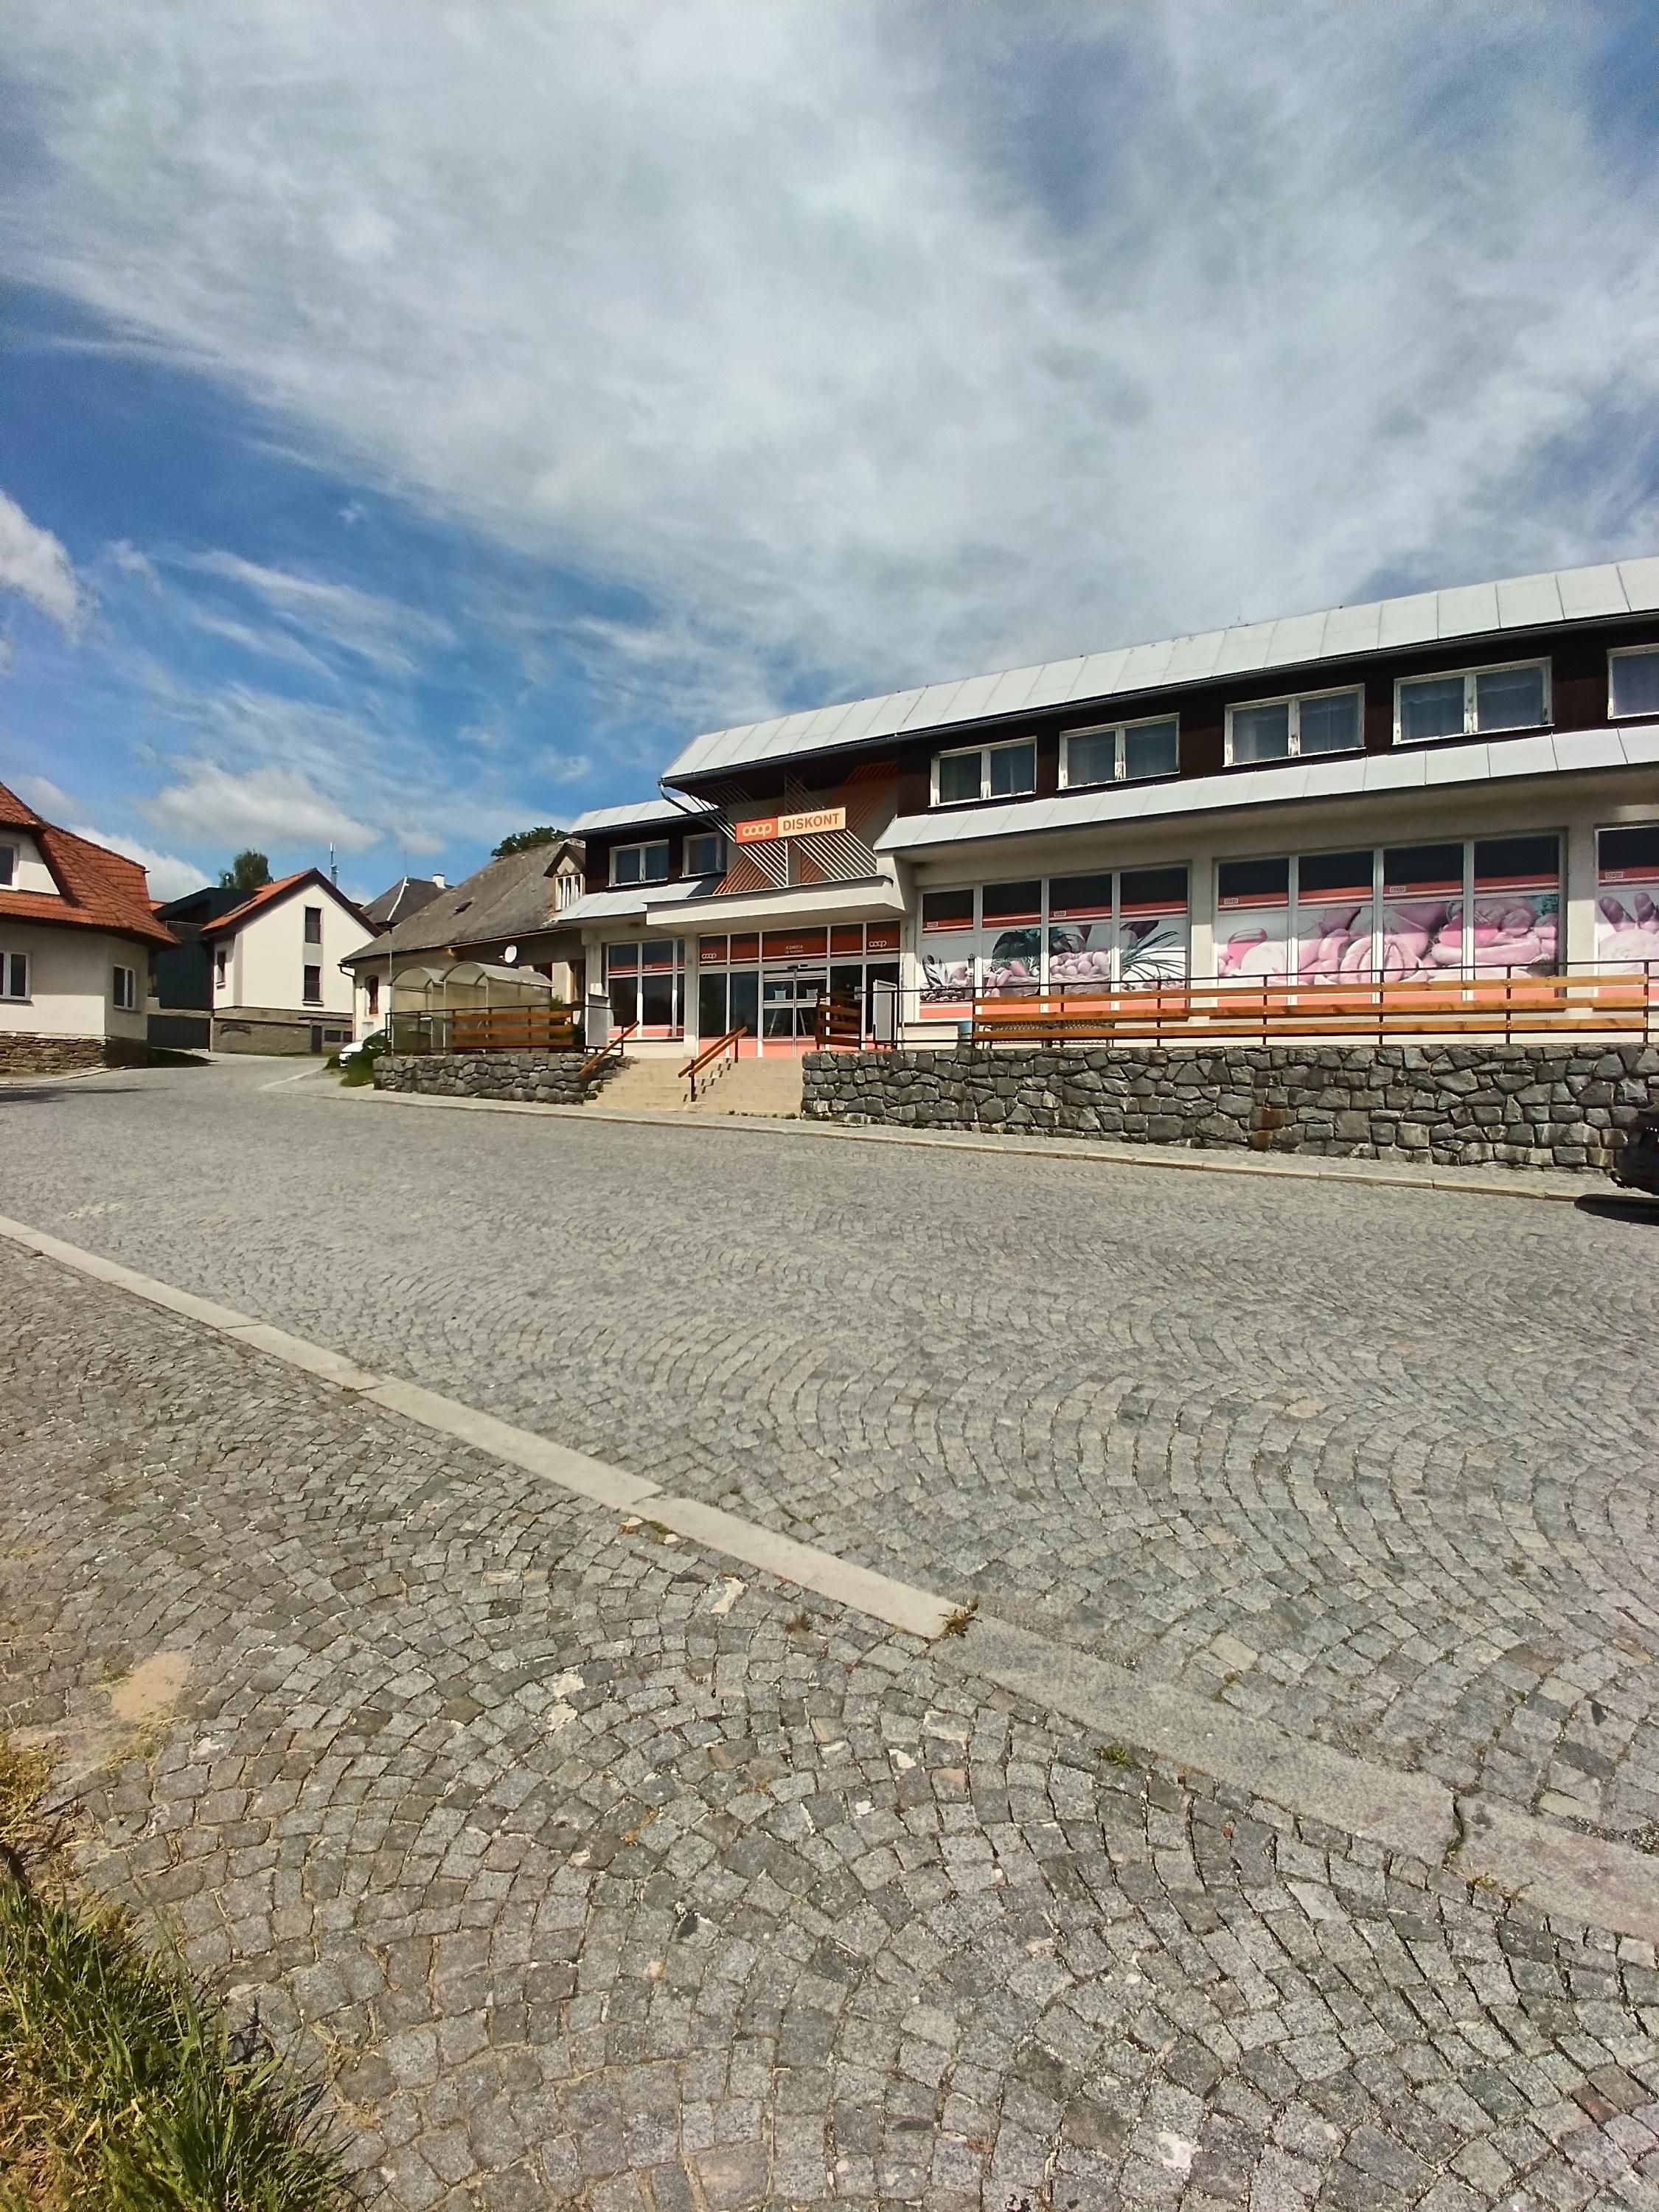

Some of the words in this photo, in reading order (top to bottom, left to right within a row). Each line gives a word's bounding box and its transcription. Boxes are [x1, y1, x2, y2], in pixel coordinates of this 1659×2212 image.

[742, 823, 773, 837] coop
[783, 813, 840, 831] DISKONT
[869, 940, 887, 948] coop
